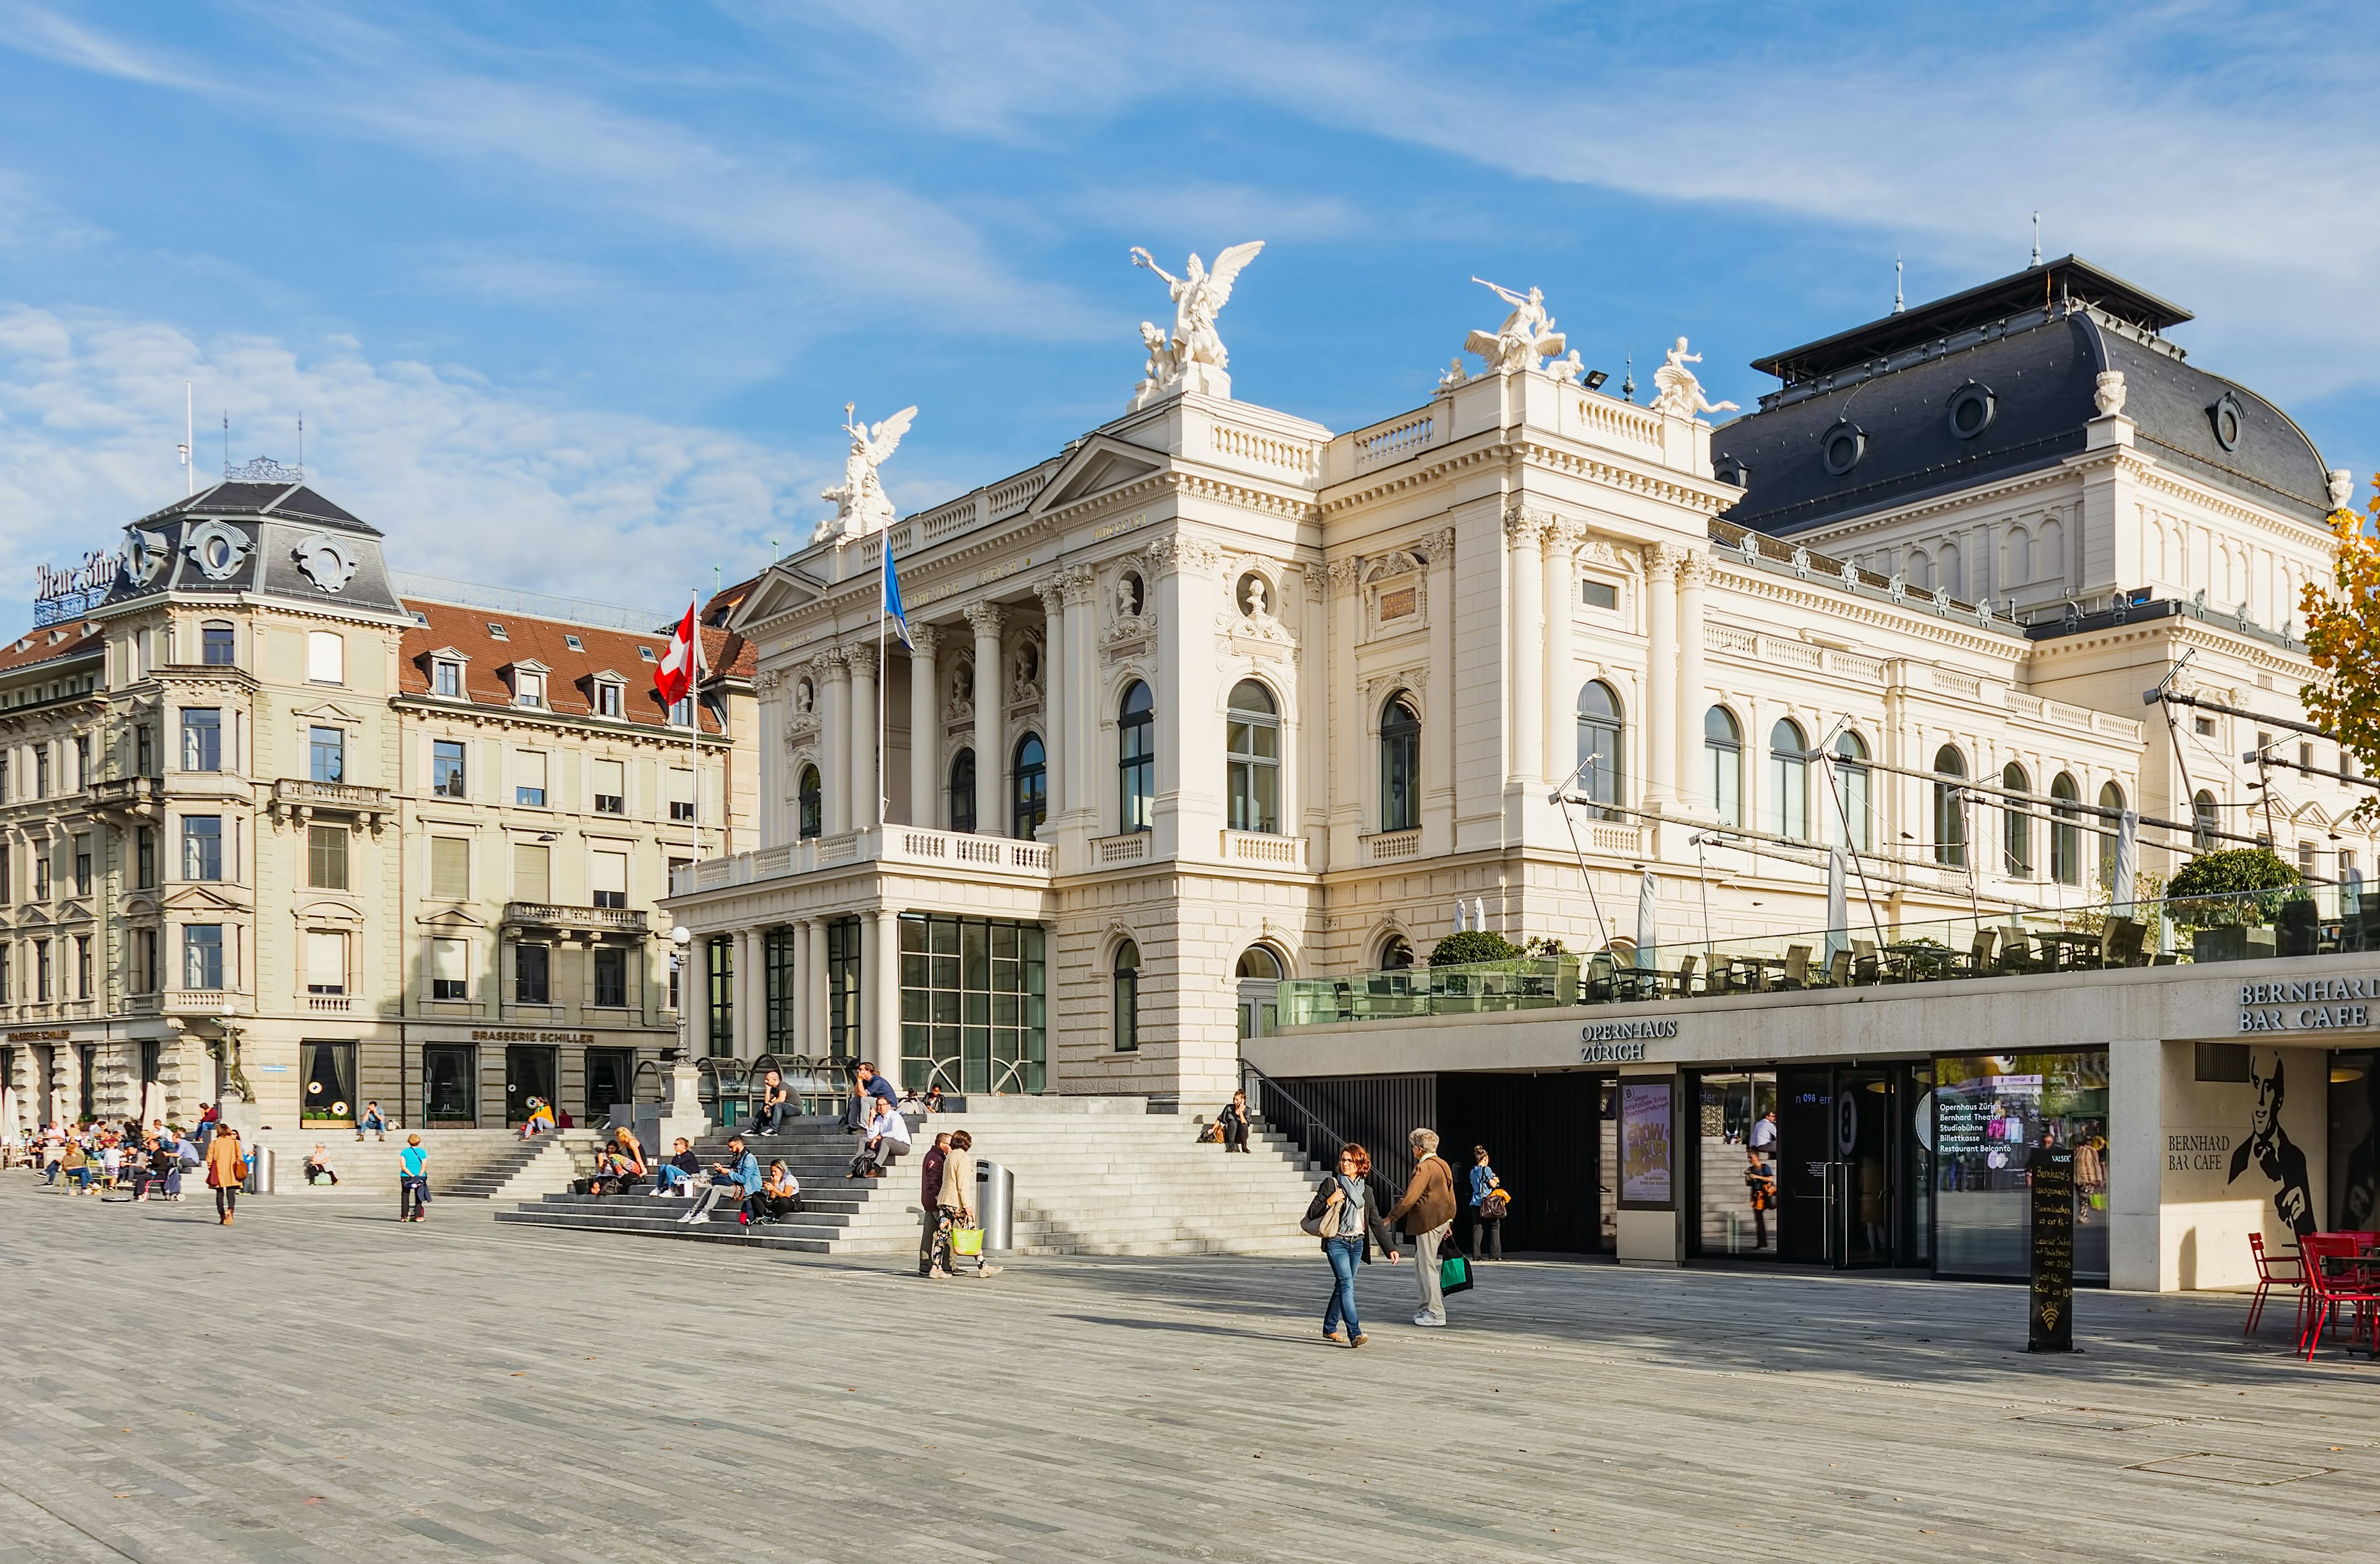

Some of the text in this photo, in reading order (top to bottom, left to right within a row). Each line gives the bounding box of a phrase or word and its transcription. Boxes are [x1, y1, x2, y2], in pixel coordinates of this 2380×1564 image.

[2239, 1005, 2368, 1032] BAR CAFE
[472, 1030, 595, 1044] BRASSERIE SCHILLER
[1581, 1020, 1677, 1041] OPERNHAUS
[1581, 1041, 1645, 1063] ZÜRICH
[1803, 1093, 1816, 1103] 098
[1939, 1103, 1977, 1113] Opernhaus
[1940, 1113, 1972, 1121] Bernhard
[1939, 1124, 1983, 1132] Studiobühne
[1940, 1134, 1980, 1142] Billettkasse
[2168, 1135, 2230, 1151] BERNHARD
[2168, 1154, 2222, 1170] BAR CAFE
